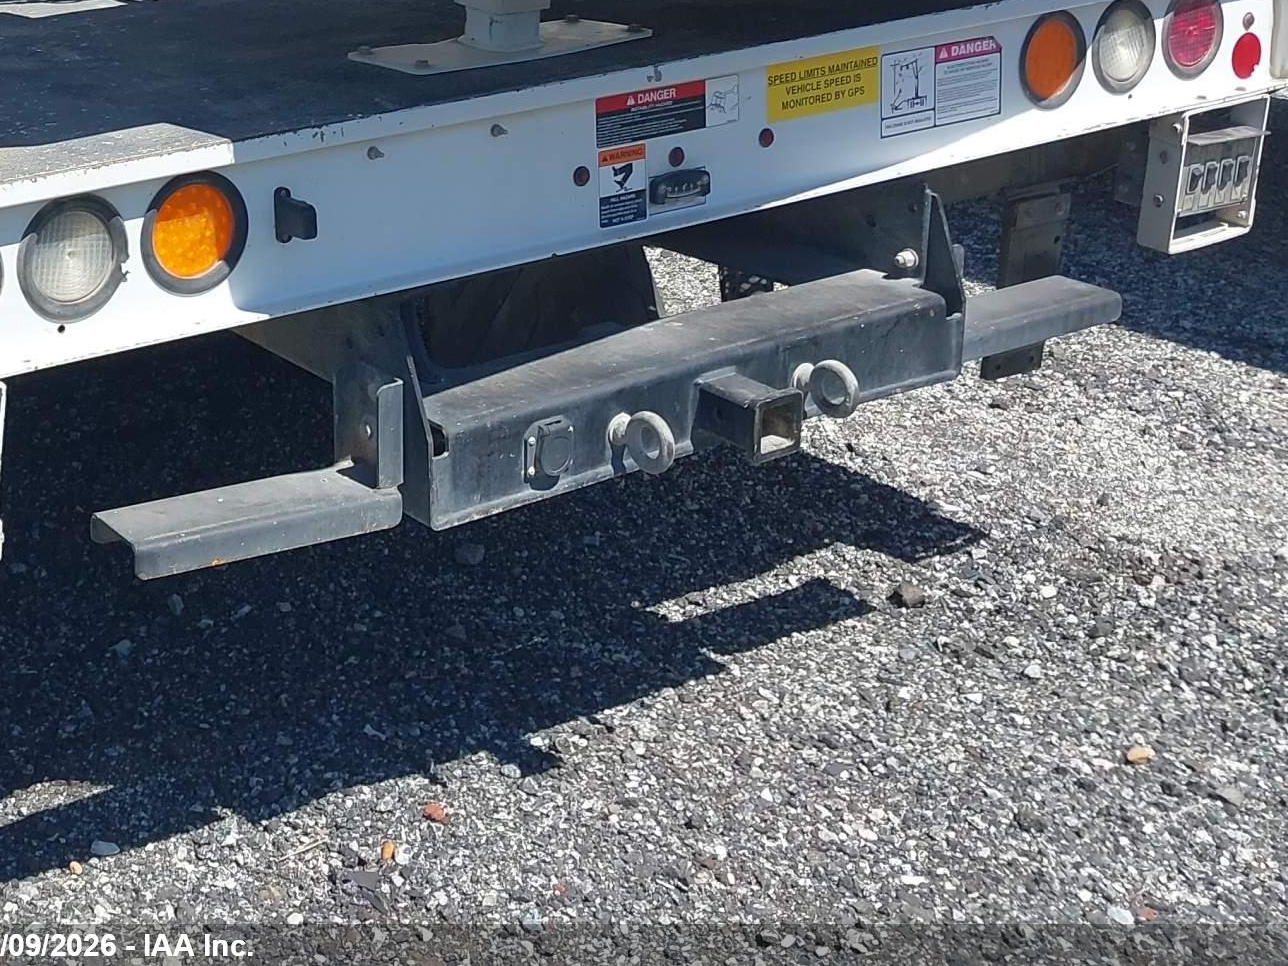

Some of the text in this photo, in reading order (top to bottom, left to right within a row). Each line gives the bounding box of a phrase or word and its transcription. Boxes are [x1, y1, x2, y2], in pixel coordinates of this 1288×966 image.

[951, 39, 997, 56] DANGER
[768, 56, 878, 86] SPEED LIMITS MAINTAINED
[786, 73, 862, 96] VEHICLE SPEED IS
[637, 87, 677, 104] DANGER
[781, 86, 865, 110] MONITORED BY GPS
[609, 148, 643, 160] WARNING
